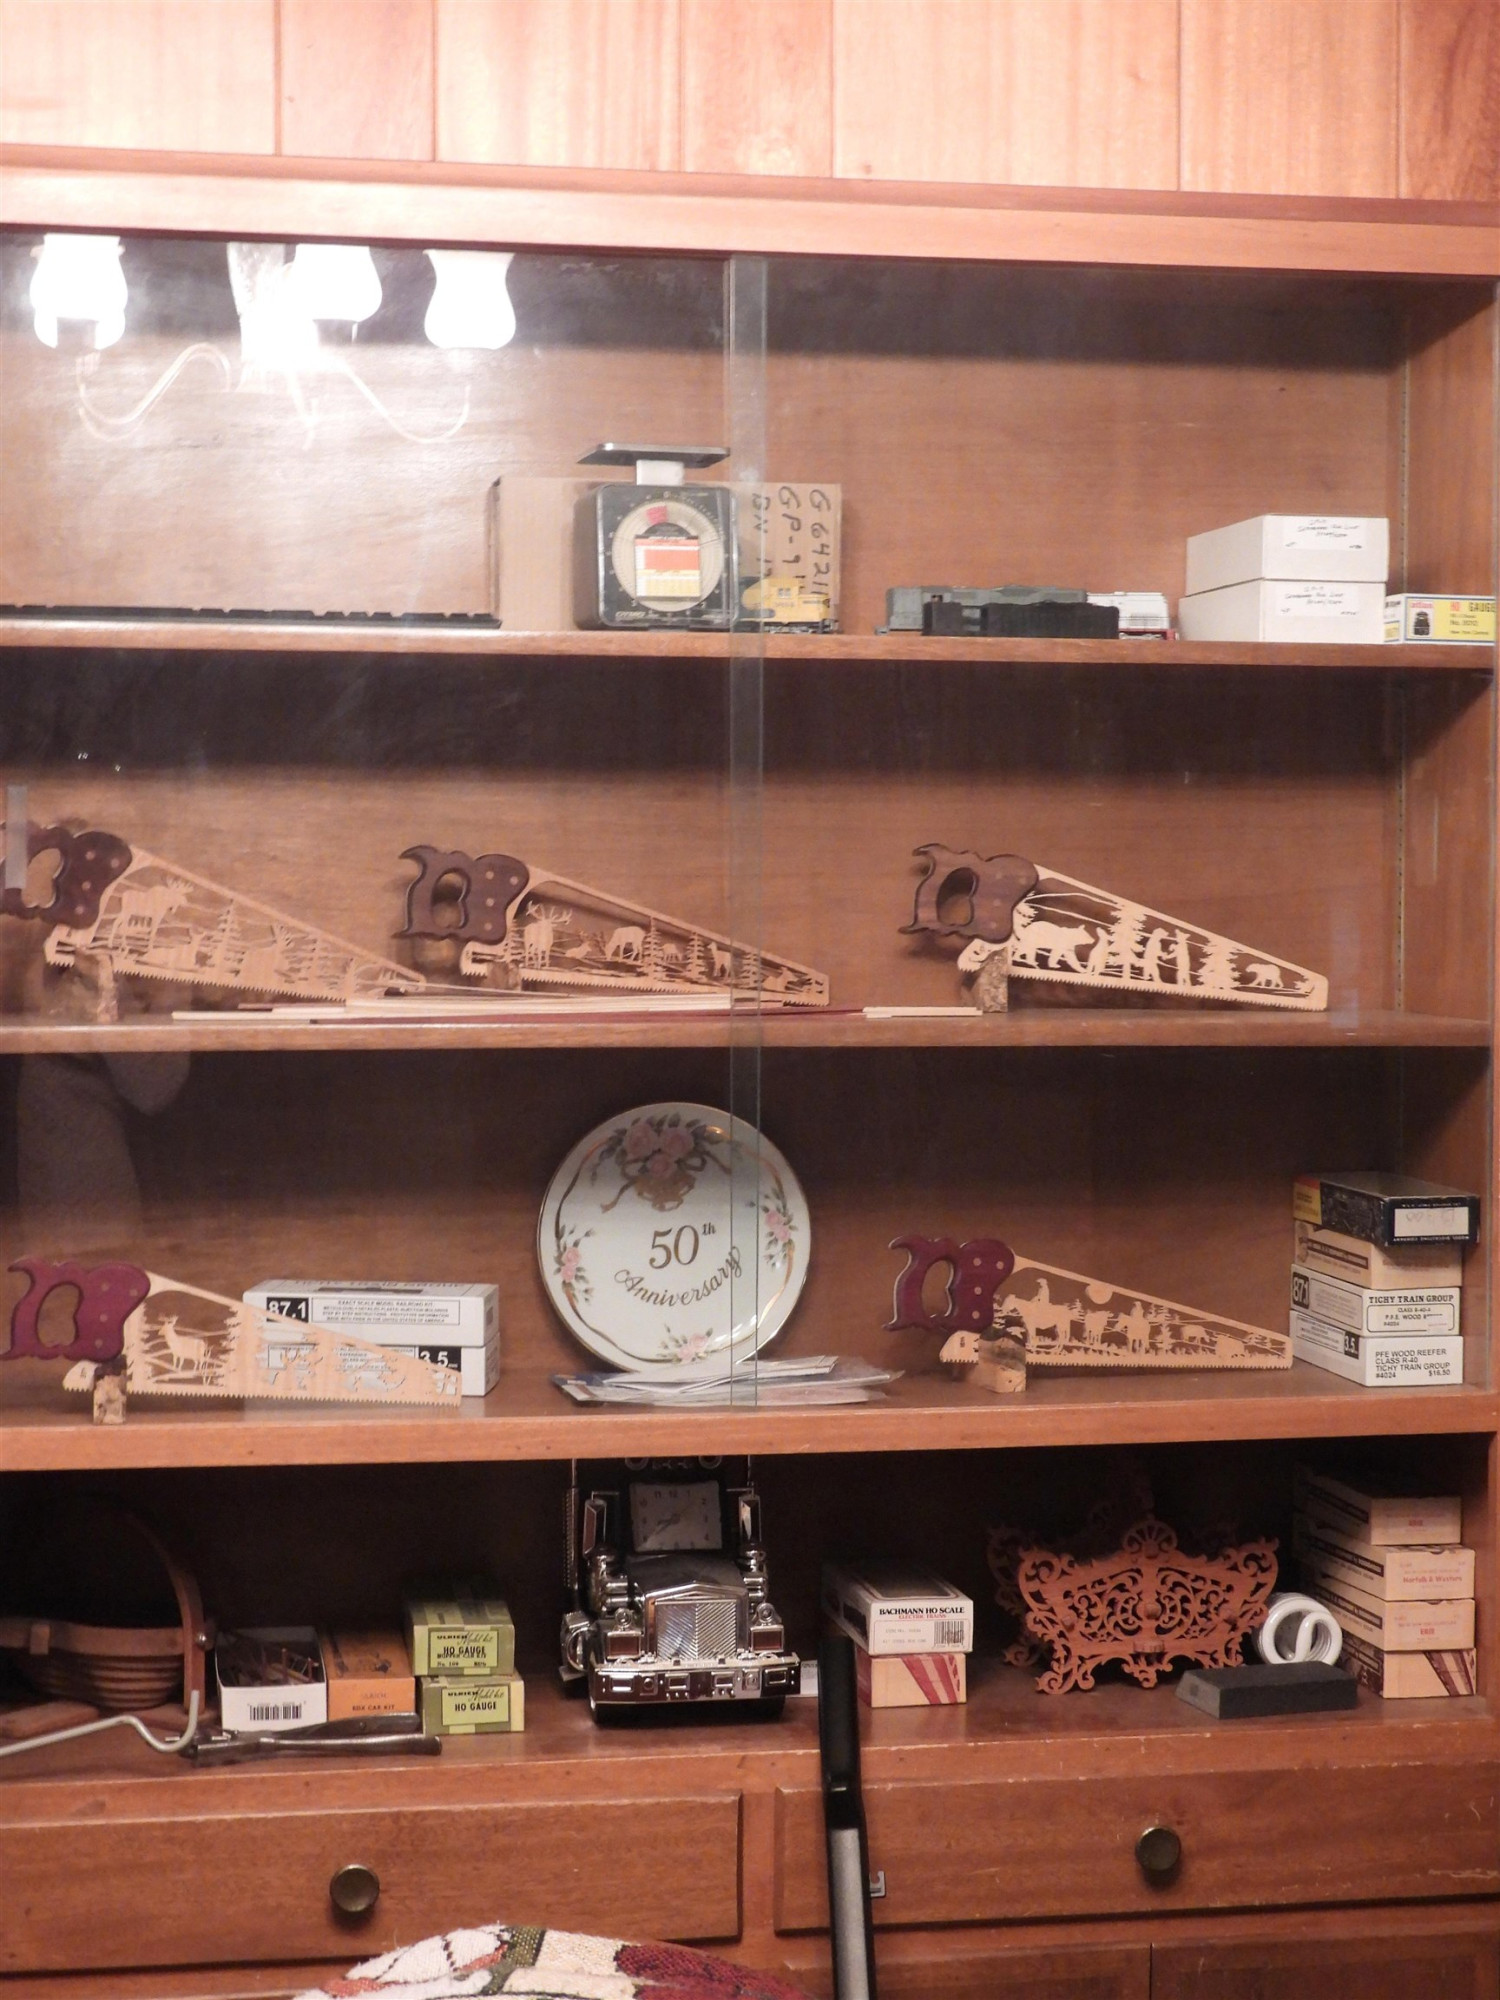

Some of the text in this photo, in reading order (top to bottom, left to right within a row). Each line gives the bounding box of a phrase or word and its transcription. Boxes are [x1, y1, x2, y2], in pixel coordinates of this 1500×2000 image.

[614, 1246, 742, 1307] Anniversary
[1369, 1296, 1395, 1304] TICHY
[1417, 1348, 1447, 1356] REEFER
[1402, 1356, 1418, 1364] R-40
[1376, 1364, 1398, 1372] TICHY
[1424, 1362, 1450, 1370] GROUP
[443, 1646, 486, 1656] HO GAUGE
[455, 1702, 496, 1711] HO GAUGE
